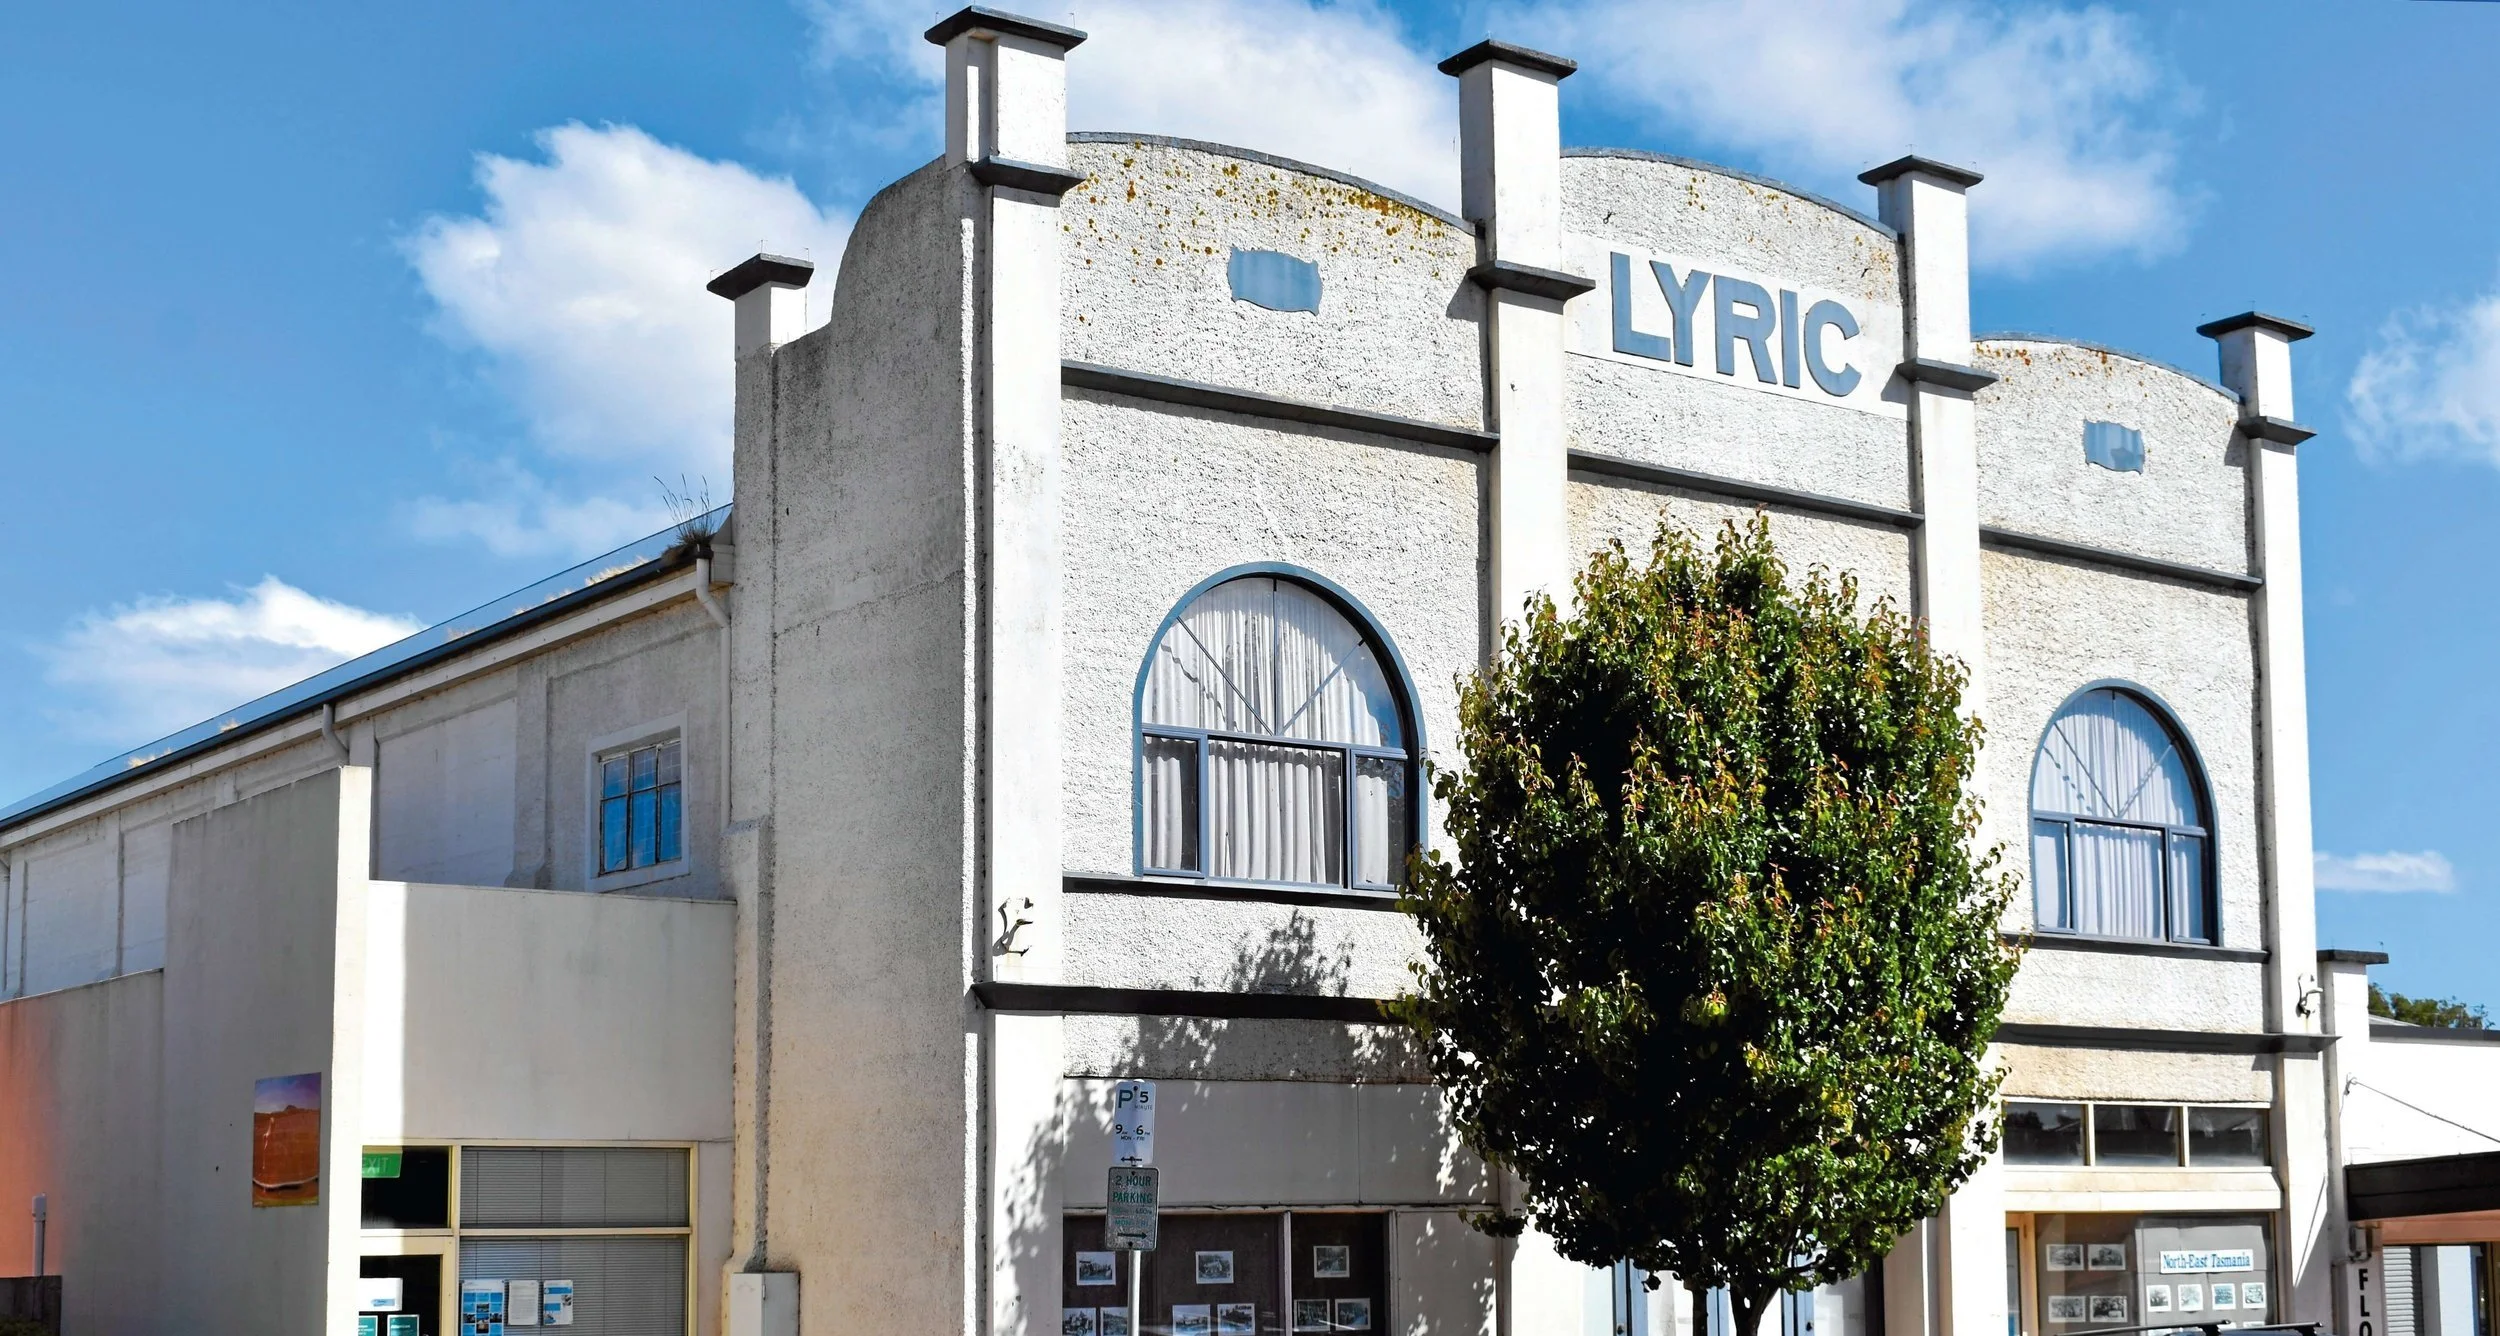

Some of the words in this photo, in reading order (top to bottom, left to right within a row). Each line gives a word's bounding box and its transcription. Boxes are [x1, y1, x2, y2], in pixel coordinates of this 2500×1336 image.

[1610, 251, 1862, 397] LYRIC
[1118, 1089, 1133, 1108] P
[1140, 1091, 1149, 1103] 5
[1115, 1175, 1123, 1186] 2
[1126, 1175, 1152, 1187] HOUR
[1112, 1191, 1153, 1204] PARKING
[2163, 1254, 2207, 1268] North-East
[2211, 1251, 2251, 1268] Tasmania
